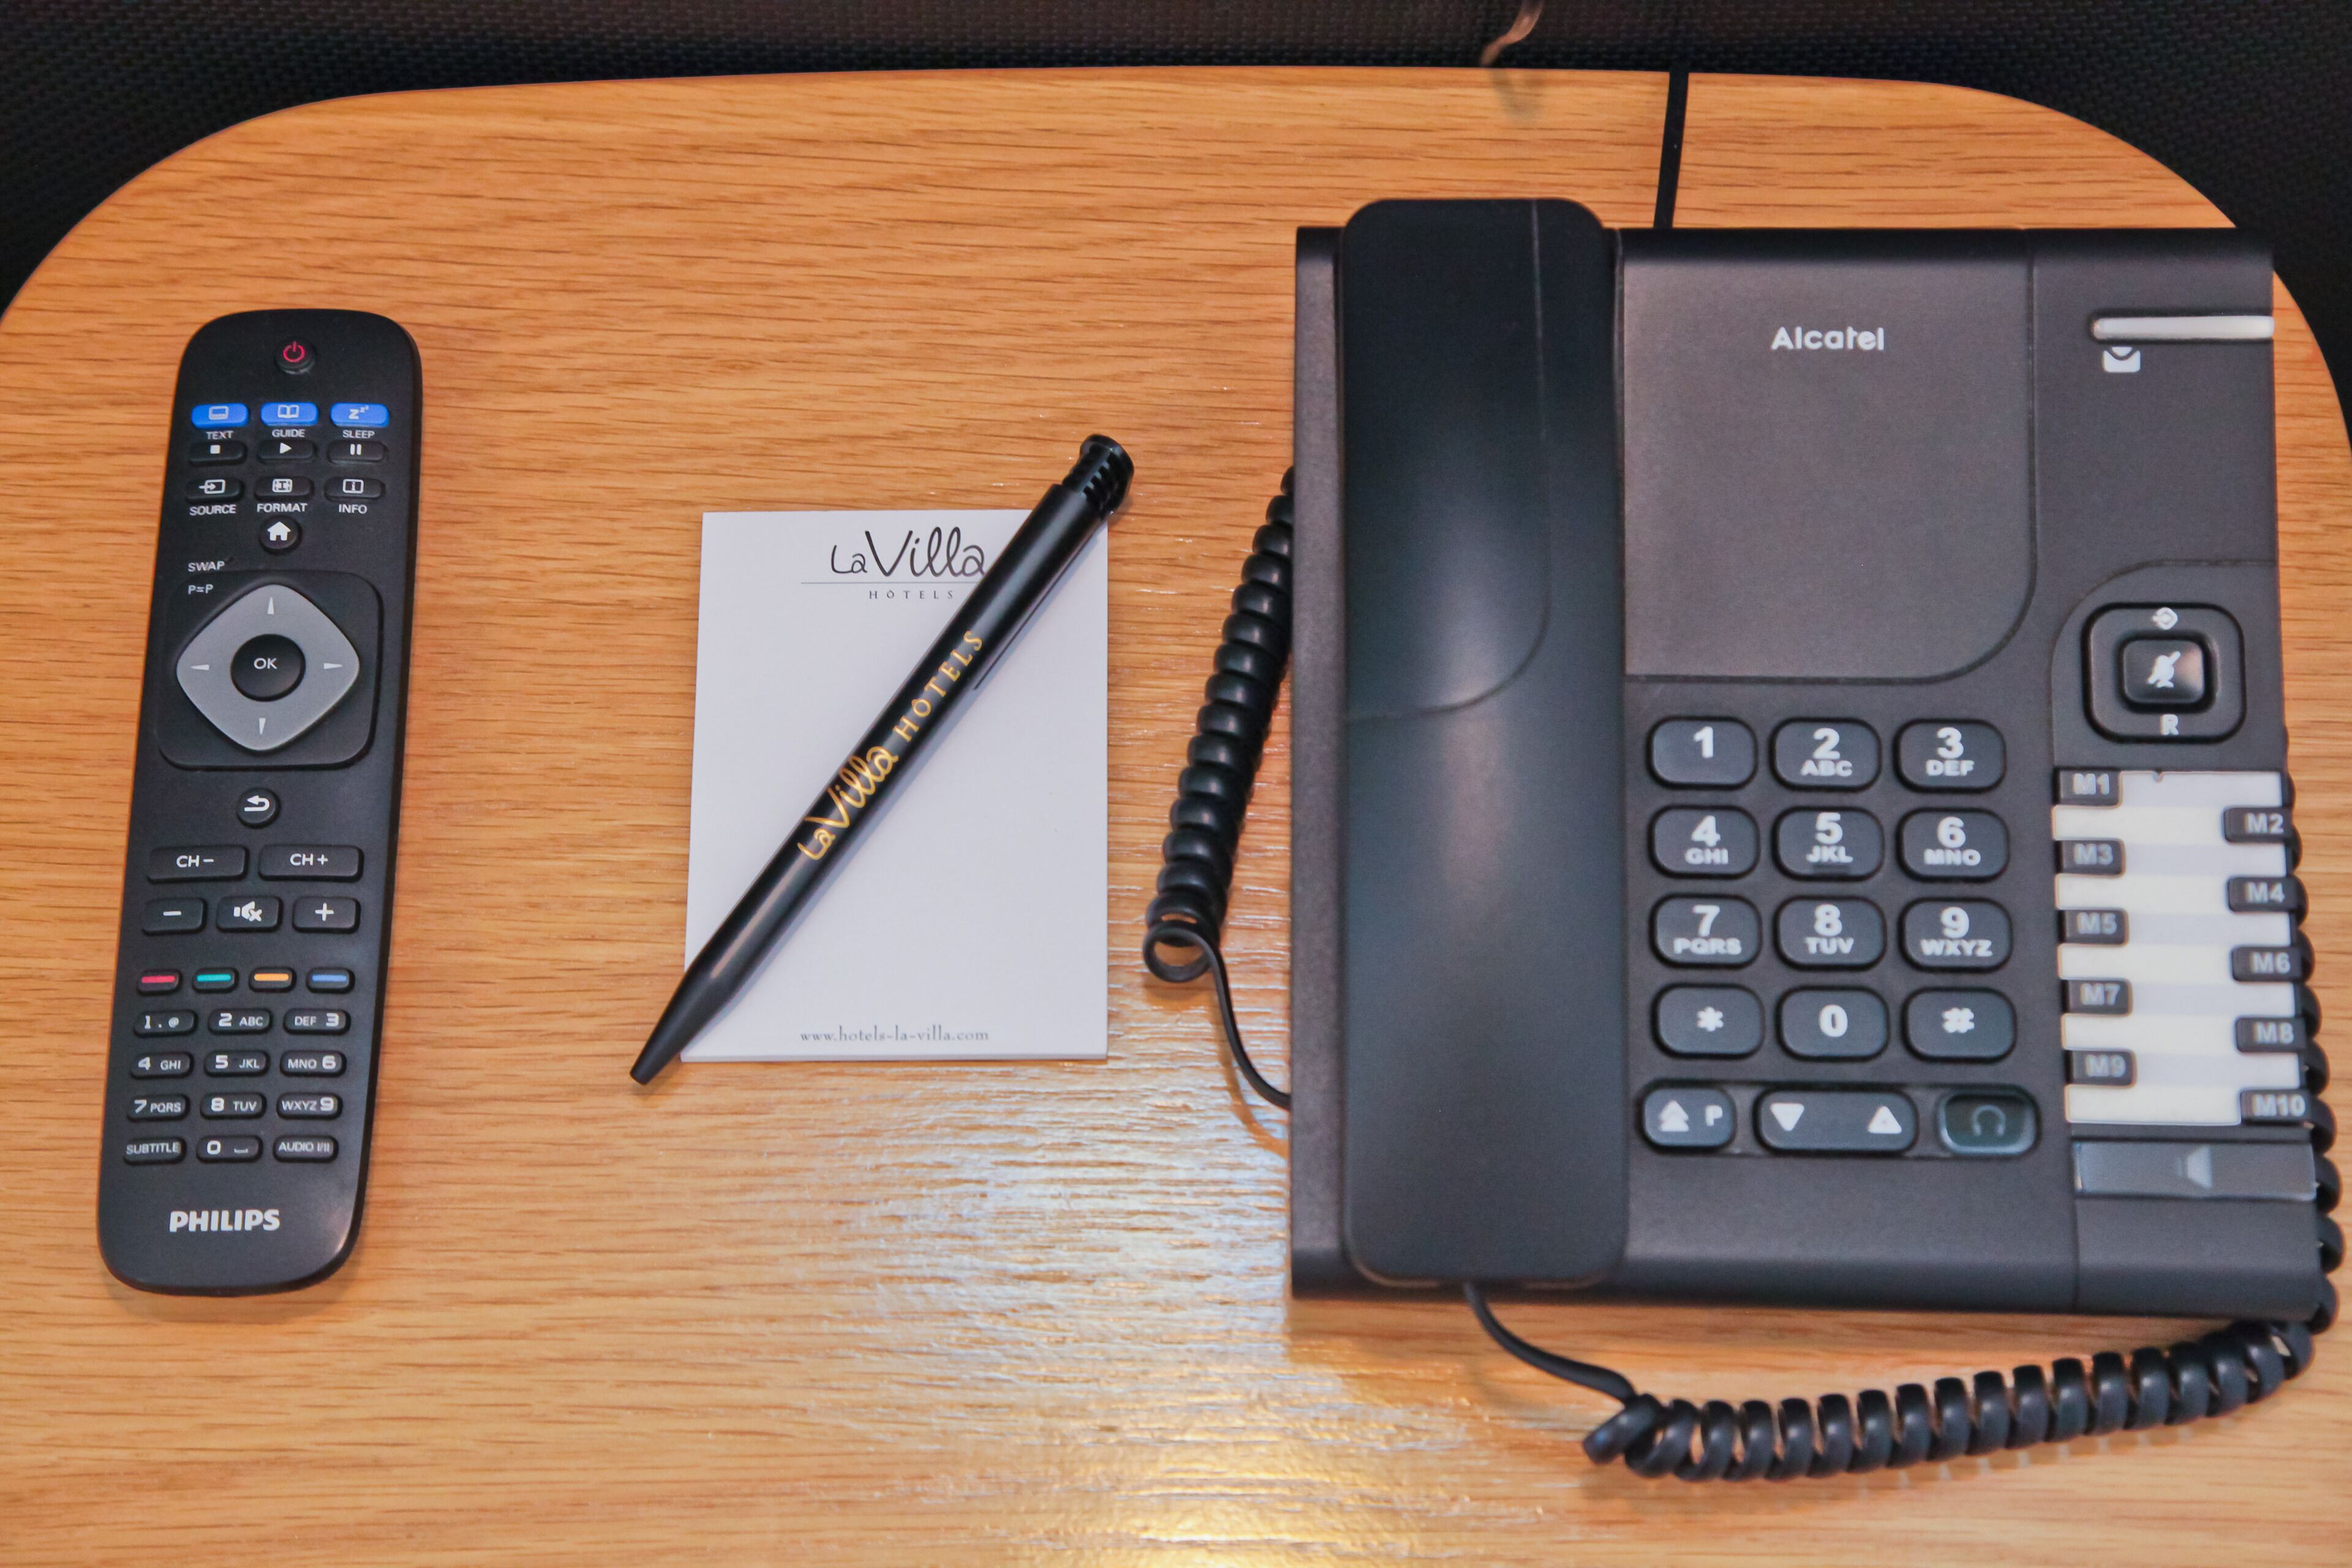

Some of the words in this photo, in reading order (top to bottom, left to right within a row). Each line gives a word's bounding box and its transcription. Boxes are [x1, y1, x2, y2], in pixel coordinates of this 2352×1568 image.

[1770, 326, 1884, 350] Alcatel
[206, 431, 233, 440] TEXT
[272, 429, 305, 438] GUIDE
[342, 430, 375, 439] SLEEP
[189, 505, 236, 515] SOURCE
[257, 503, 307, 513] FORMAT
[338, 504, 368, 514] INFO
[187, 561, 225, 571] SWAP
[254, 657, 277, 670] OK
[2160, 714, 2179, 736] R
[1692, 726, 1714, 758] 1
[1812, 728, 1841, 760] 2
[1936, 726, 1964, 759] 3
[1801, 760, 1853, 777] ABC
[1926, 760, 1975, 776] DEF
[2072, 774, 2110, 795] M1
[1691, 815, 1721, 846] 4
[1815, 812, 1843, 845] 5
[2245, 812, 2284, 834] M2
[1937, 816, 1967, 848] 6
[1684, 848, 1729, 865] GHI
[1806, 846, 1853, 863] JKL
[1923, 849, 1982, 866] MNO
[2073, 843, 2114, 865] M3
[2245, 881, 2285, 903] M4
[1692, 905, 1720, 937] 7
[1814, 903, 1843, 937] 8
[1939, 907, 1970, 938] 9
[2077, 911, 2117, 935] M5
[1673, 938, 1742, 955] PQRS
[1804, 937, 1854, 954] TUV
[1920, 939, 1993, 957] WXYZ
[2250, 951, 2291, 974] M6
[2081, 983, 2120, 1006] M7
[144, 1016, 151, 1029] 1
[217, 1012, 232, 1027] 2
[239, 1016, 263, 1027] ABC
[294, 1016, 317, 1026] DEF
[325, 1012, 339, 1027] 3
[1818, 1004, 1849, 1038] 0
[800, 1025, 990, 1041] www.hotels-la-villa.com
[2255, 1022, 2294, 1044] M8
[138, 1056, 151, 1071] 4
[160, 1061, 181, 1070] GHI
[214, 1055, 229, 1069] 5
[239, 1059, 260, 1069] JKL
[287, 1058, 317, 1069] MNO
[322, 1055, 337, 1070] 6
[2085, 1054, 2126, 1077] M9
[134, 1099, 148, 1114] 7
[150, 1102, 182, 1113] PQRS
[211, 1098, 225, 1112] 8
[233, 1101, 257, 1112] TUV
[282, 1101, 317, 1112] WXYZ
[320, 1097, 334, 1112] 9
[2253, 1094, 2307, 1117] M10
[1705, 1105, 1723, 1126] P
[126, 1143, 180, 1154] SUBTITLE
[207, 1140, 221, 1155] 0
[278, 1142, 315, 1152] AUDIO
[169, 1209, 281, 1233] PHILIPS
